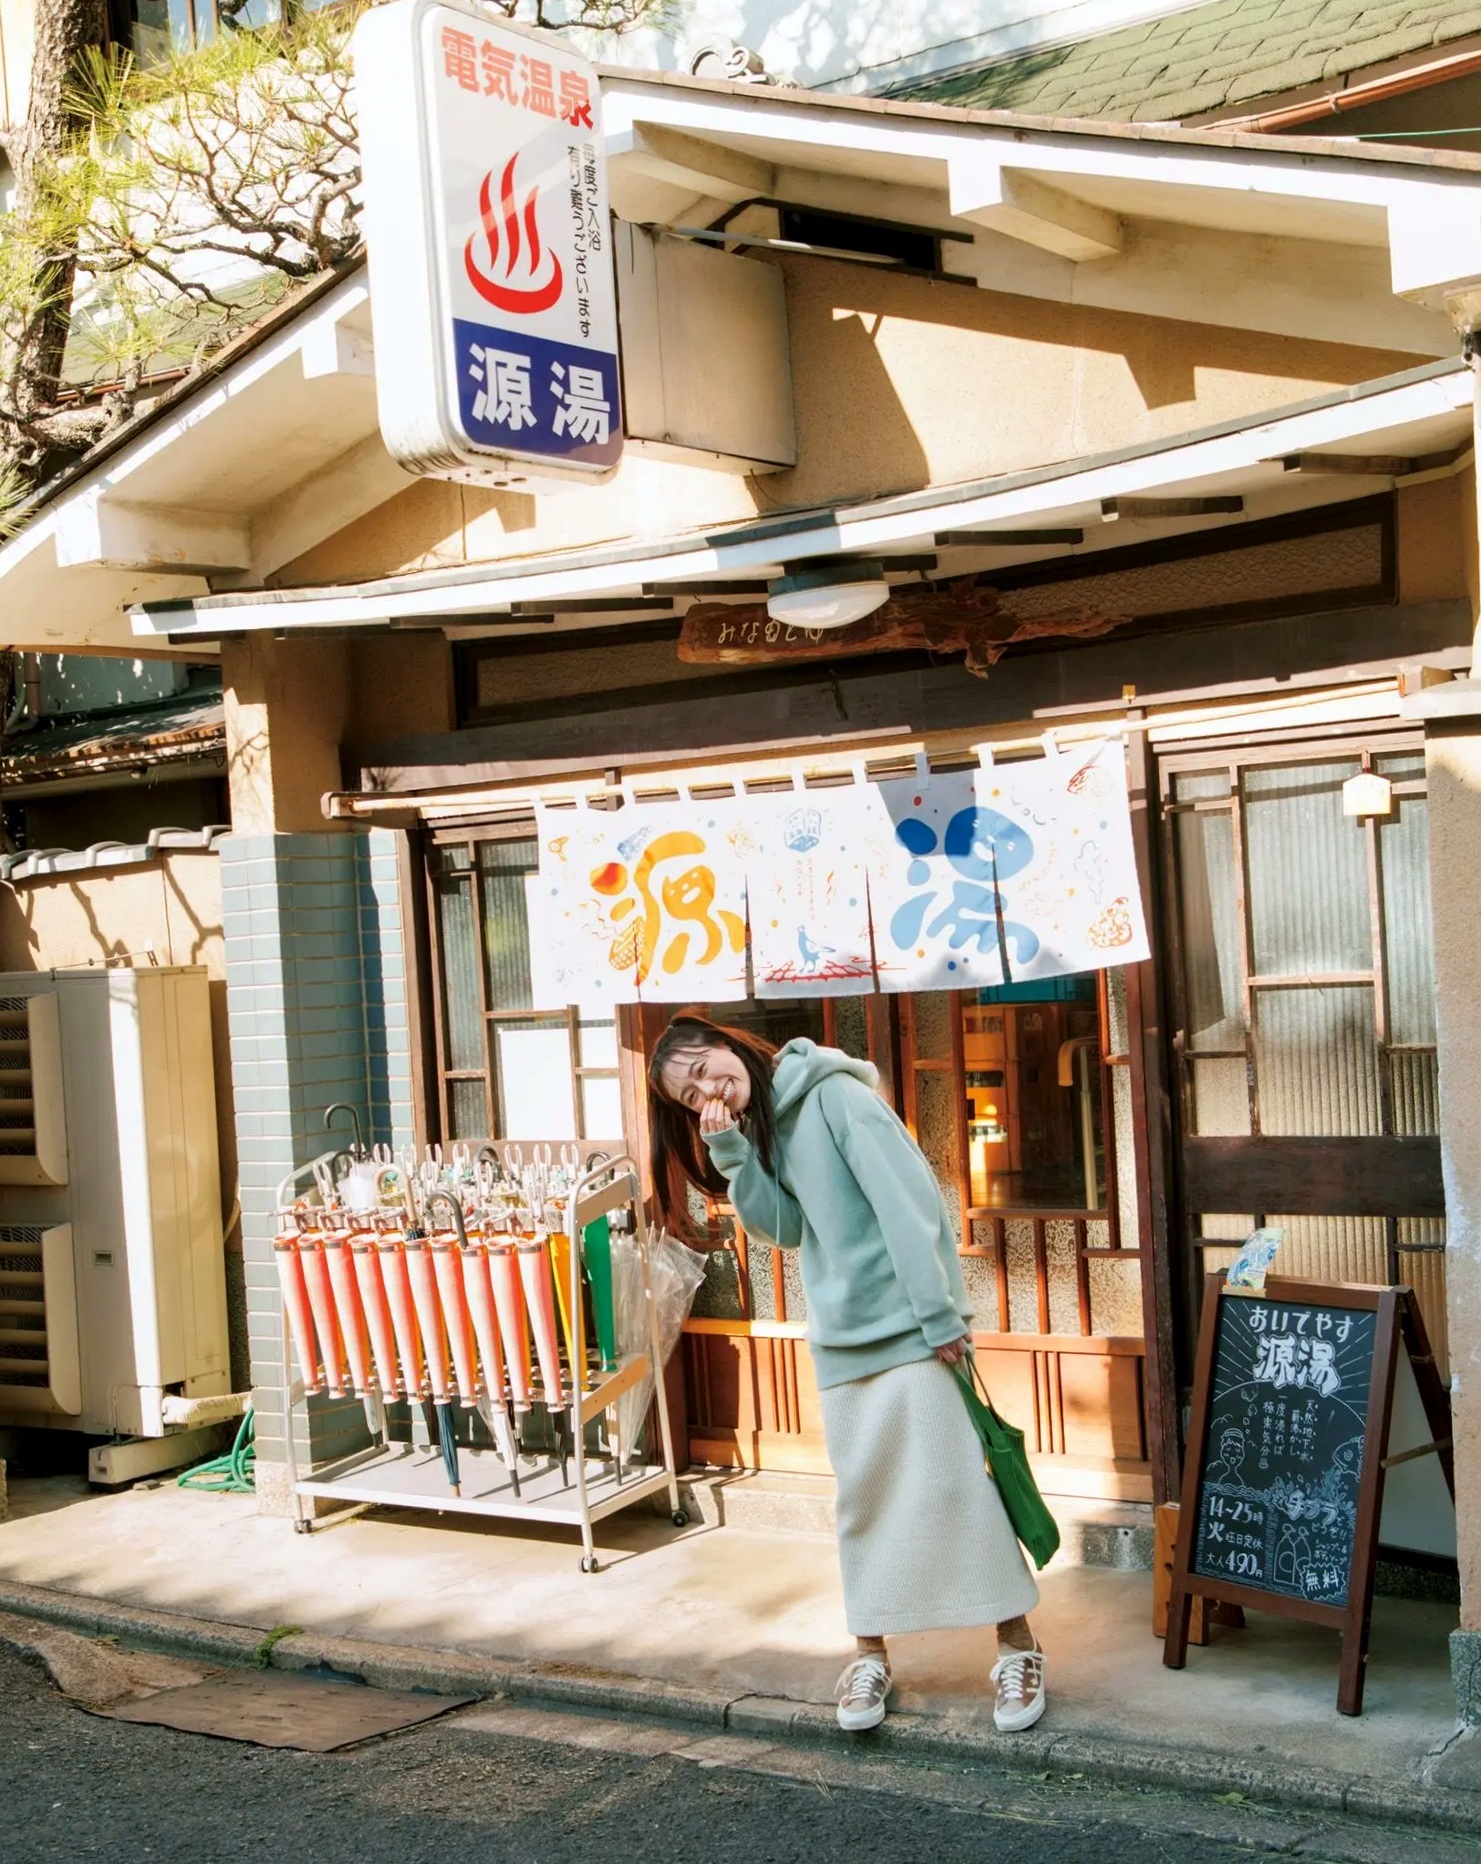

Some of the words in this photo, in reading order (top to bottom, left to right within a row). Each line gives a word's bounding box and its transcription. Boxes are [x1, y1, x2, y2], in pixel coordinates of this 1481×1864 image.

[441, 25, 594, 130] 電気温泉
[468, 342, 611, 445] 源湯
[1249, 1305, 1354, 1344] おいでやす
[1253, 1332, 1341, 1397] 源湯
[1205, 1550, 1264, 1579] 大人490円
[1305, 1567, 1340, 1592] 無料
